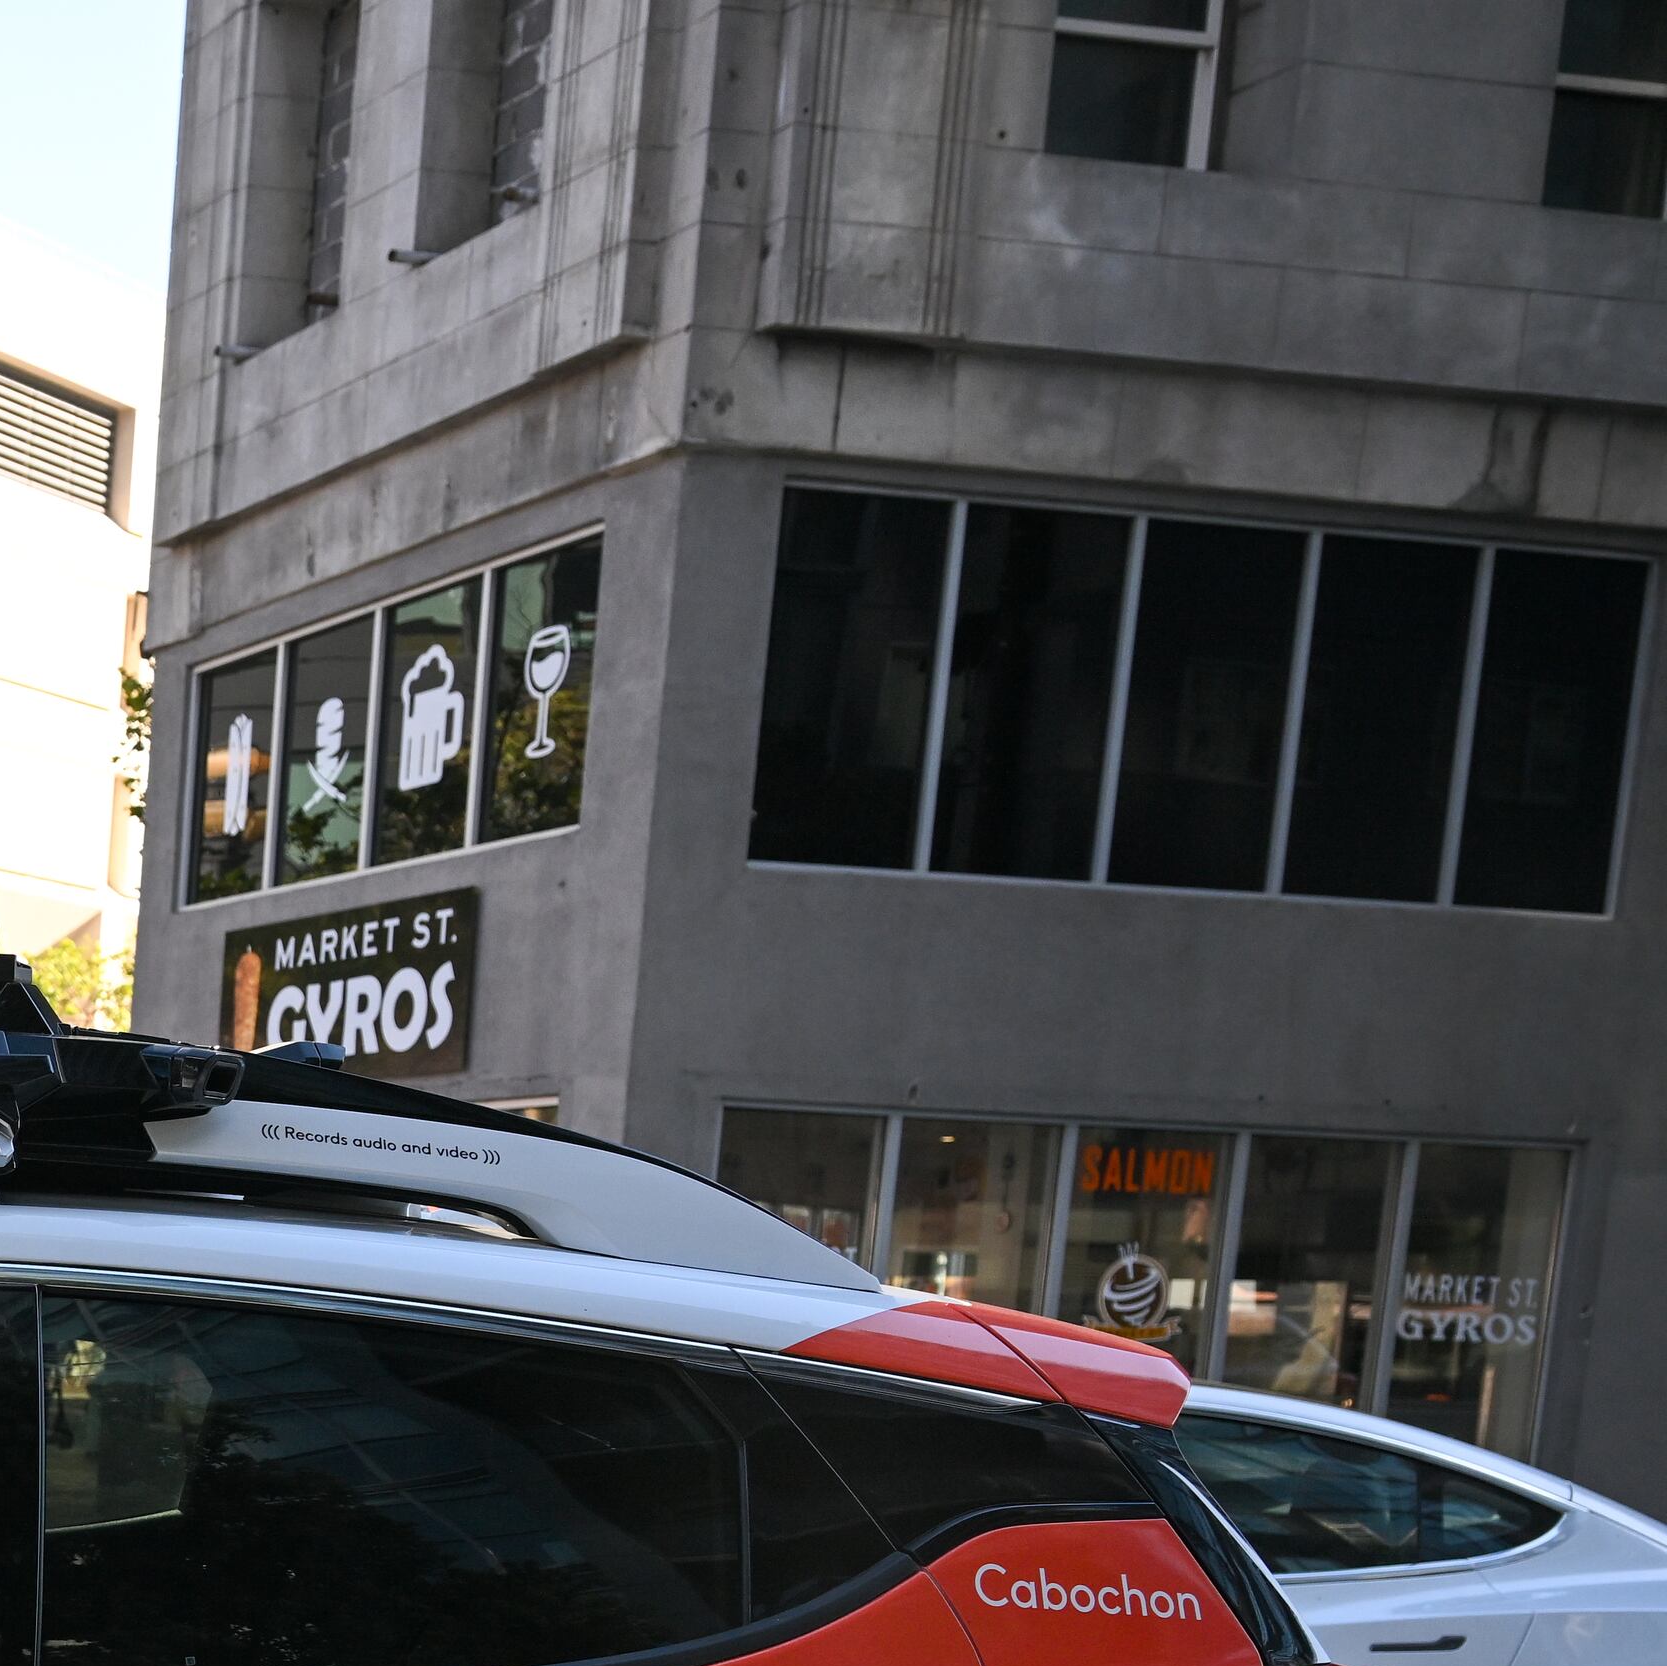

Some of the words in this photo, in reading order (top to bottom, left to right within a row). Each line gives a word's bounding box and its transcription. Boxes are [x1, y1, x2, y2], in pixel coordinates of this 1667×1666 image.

[275, 916, 401, 972] MARKET
[411, 907, 459, 950] ST.
[267, 960, 457, 1058] GYROS
[284, 1125, 349, 1147] Records
[353, 1136, 398, 1152] audio
[401, 1142, 432, 1156] and
[436, 1145, 480, 1161] video
[1081, 1144, 1214, 1193] SALMON
[1404, 1272, 1501, 1306] MARKET
[1396, 1308, 1538, 1346] GYROS
[973, 1562, 1203, 1622] Cabochon
